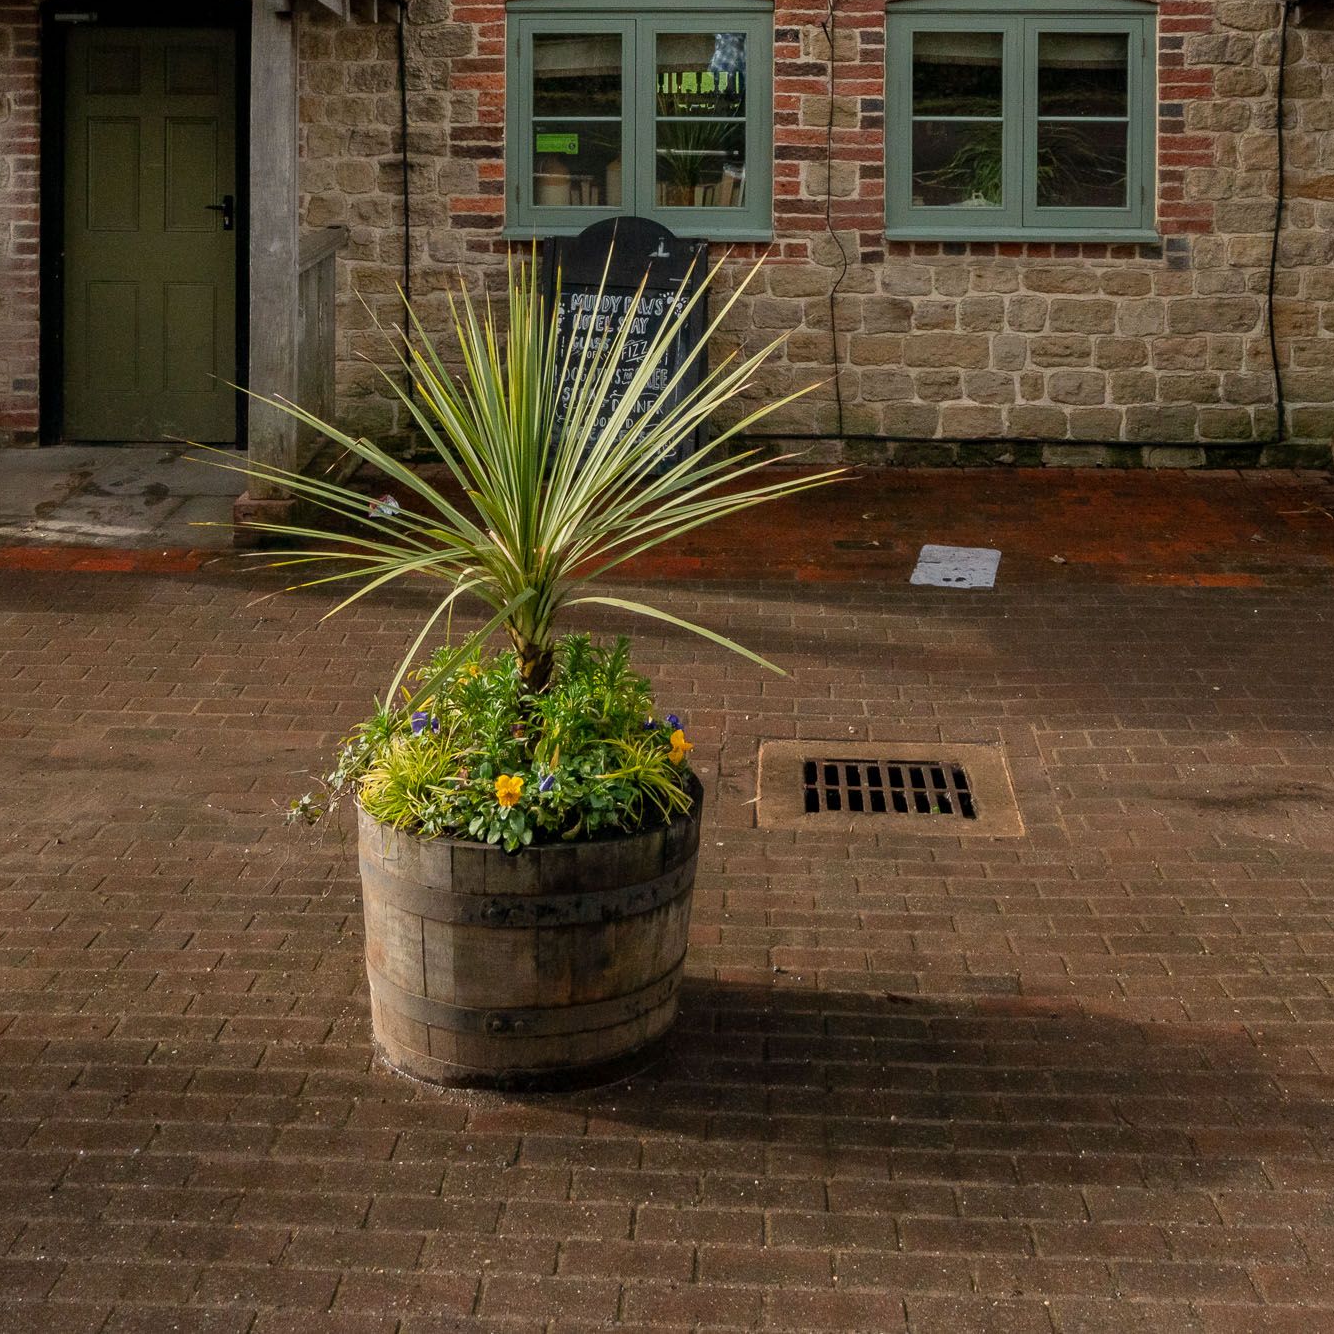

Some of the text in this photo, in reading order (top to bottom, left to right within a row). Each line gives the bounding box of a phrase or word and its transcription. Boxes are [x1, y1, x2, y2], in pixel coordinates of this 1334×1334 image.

[572, 314, 650, 334] HOEL SAY
[621, 341, 648, 360] FIZZ
[635, 368, 669, 390] EE
